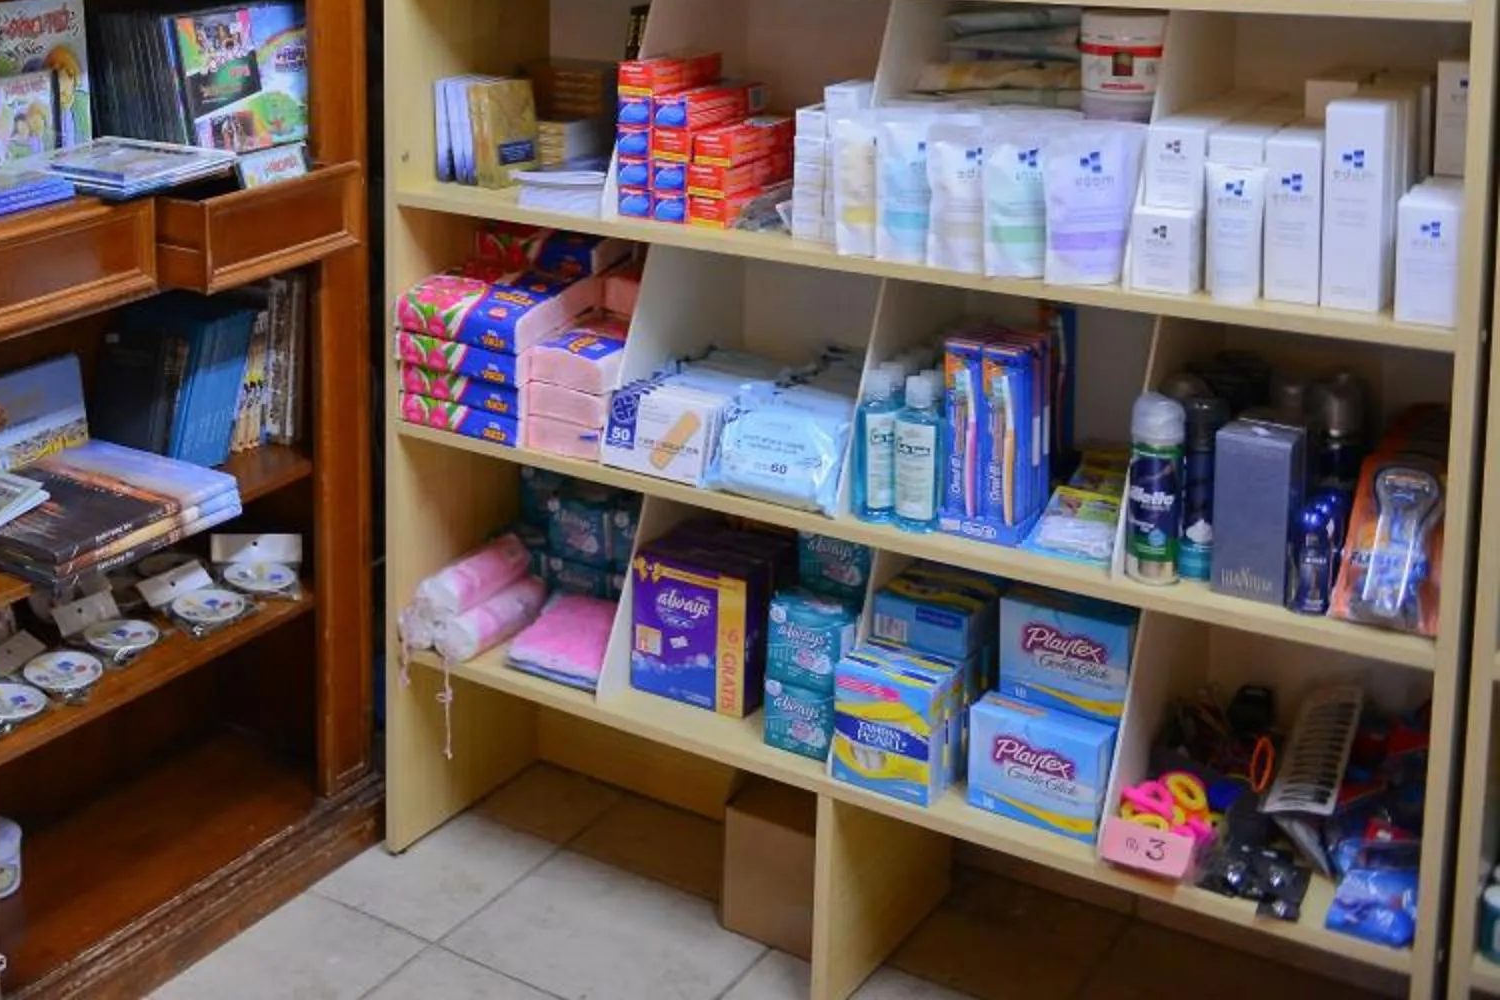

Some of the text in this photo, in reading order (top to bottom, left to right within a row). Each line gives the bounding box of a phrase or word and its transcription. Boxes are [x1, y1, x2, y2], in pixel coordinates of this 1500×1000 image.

[612, 426, 631, 441] 50
[657, 589, 710, 619] always
[777, 622, 826, 649] always
[1025, 627, 1102, 664] Playtex
[773, 696, 820, 722] always
[995, 739, 1071, 780] Playtex
[1145, 838, 1166, 861] 3
